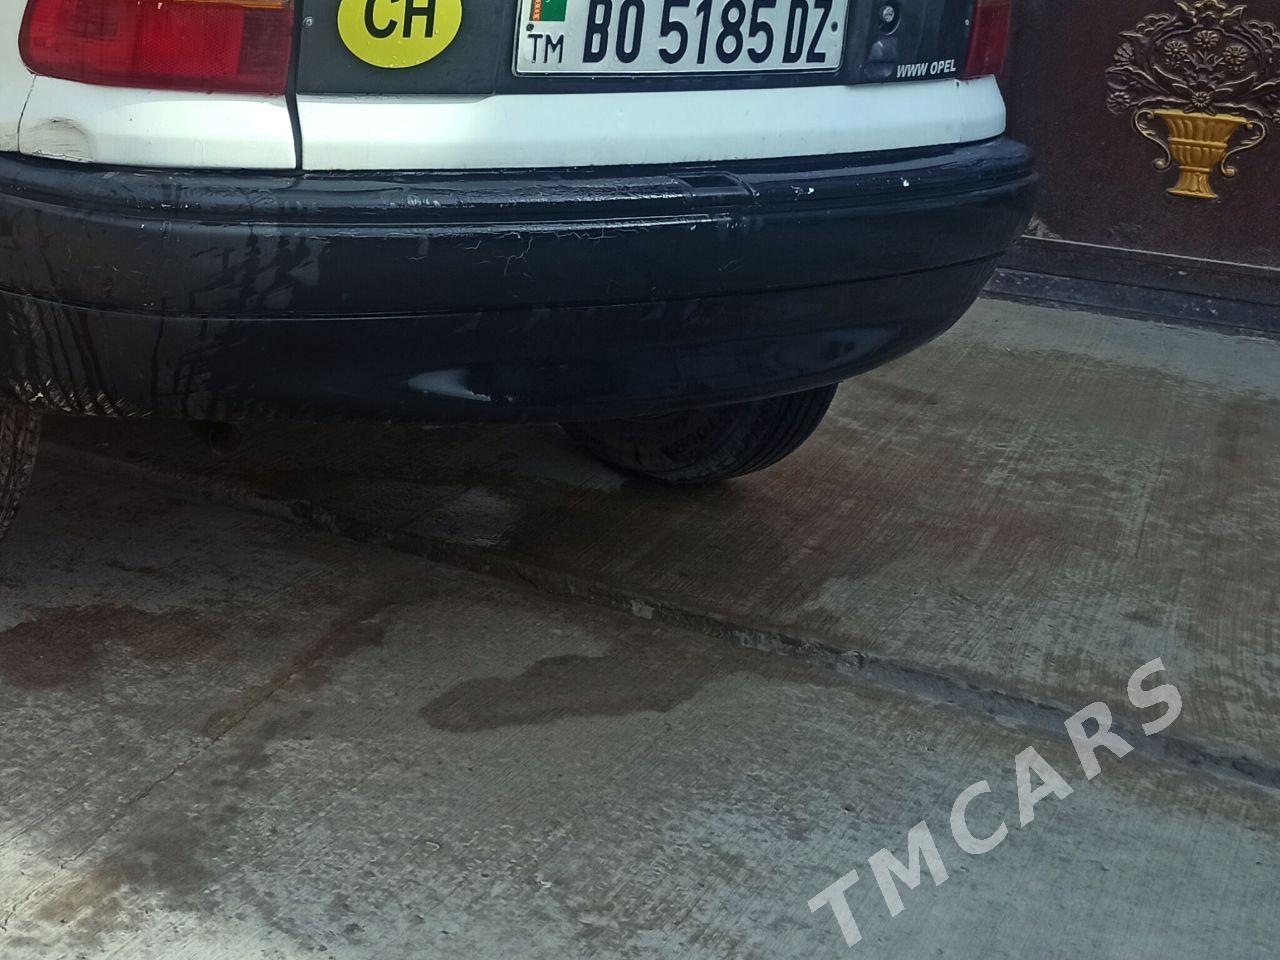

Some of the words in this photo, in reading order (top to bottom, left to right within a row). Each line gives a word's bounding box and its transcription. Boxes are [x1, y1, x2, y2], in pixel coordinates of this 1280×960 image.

[527, 33, 565, 64] TM
[896, 62, 927, 79] WWW
[929, 58, 957, 76] OPEL
